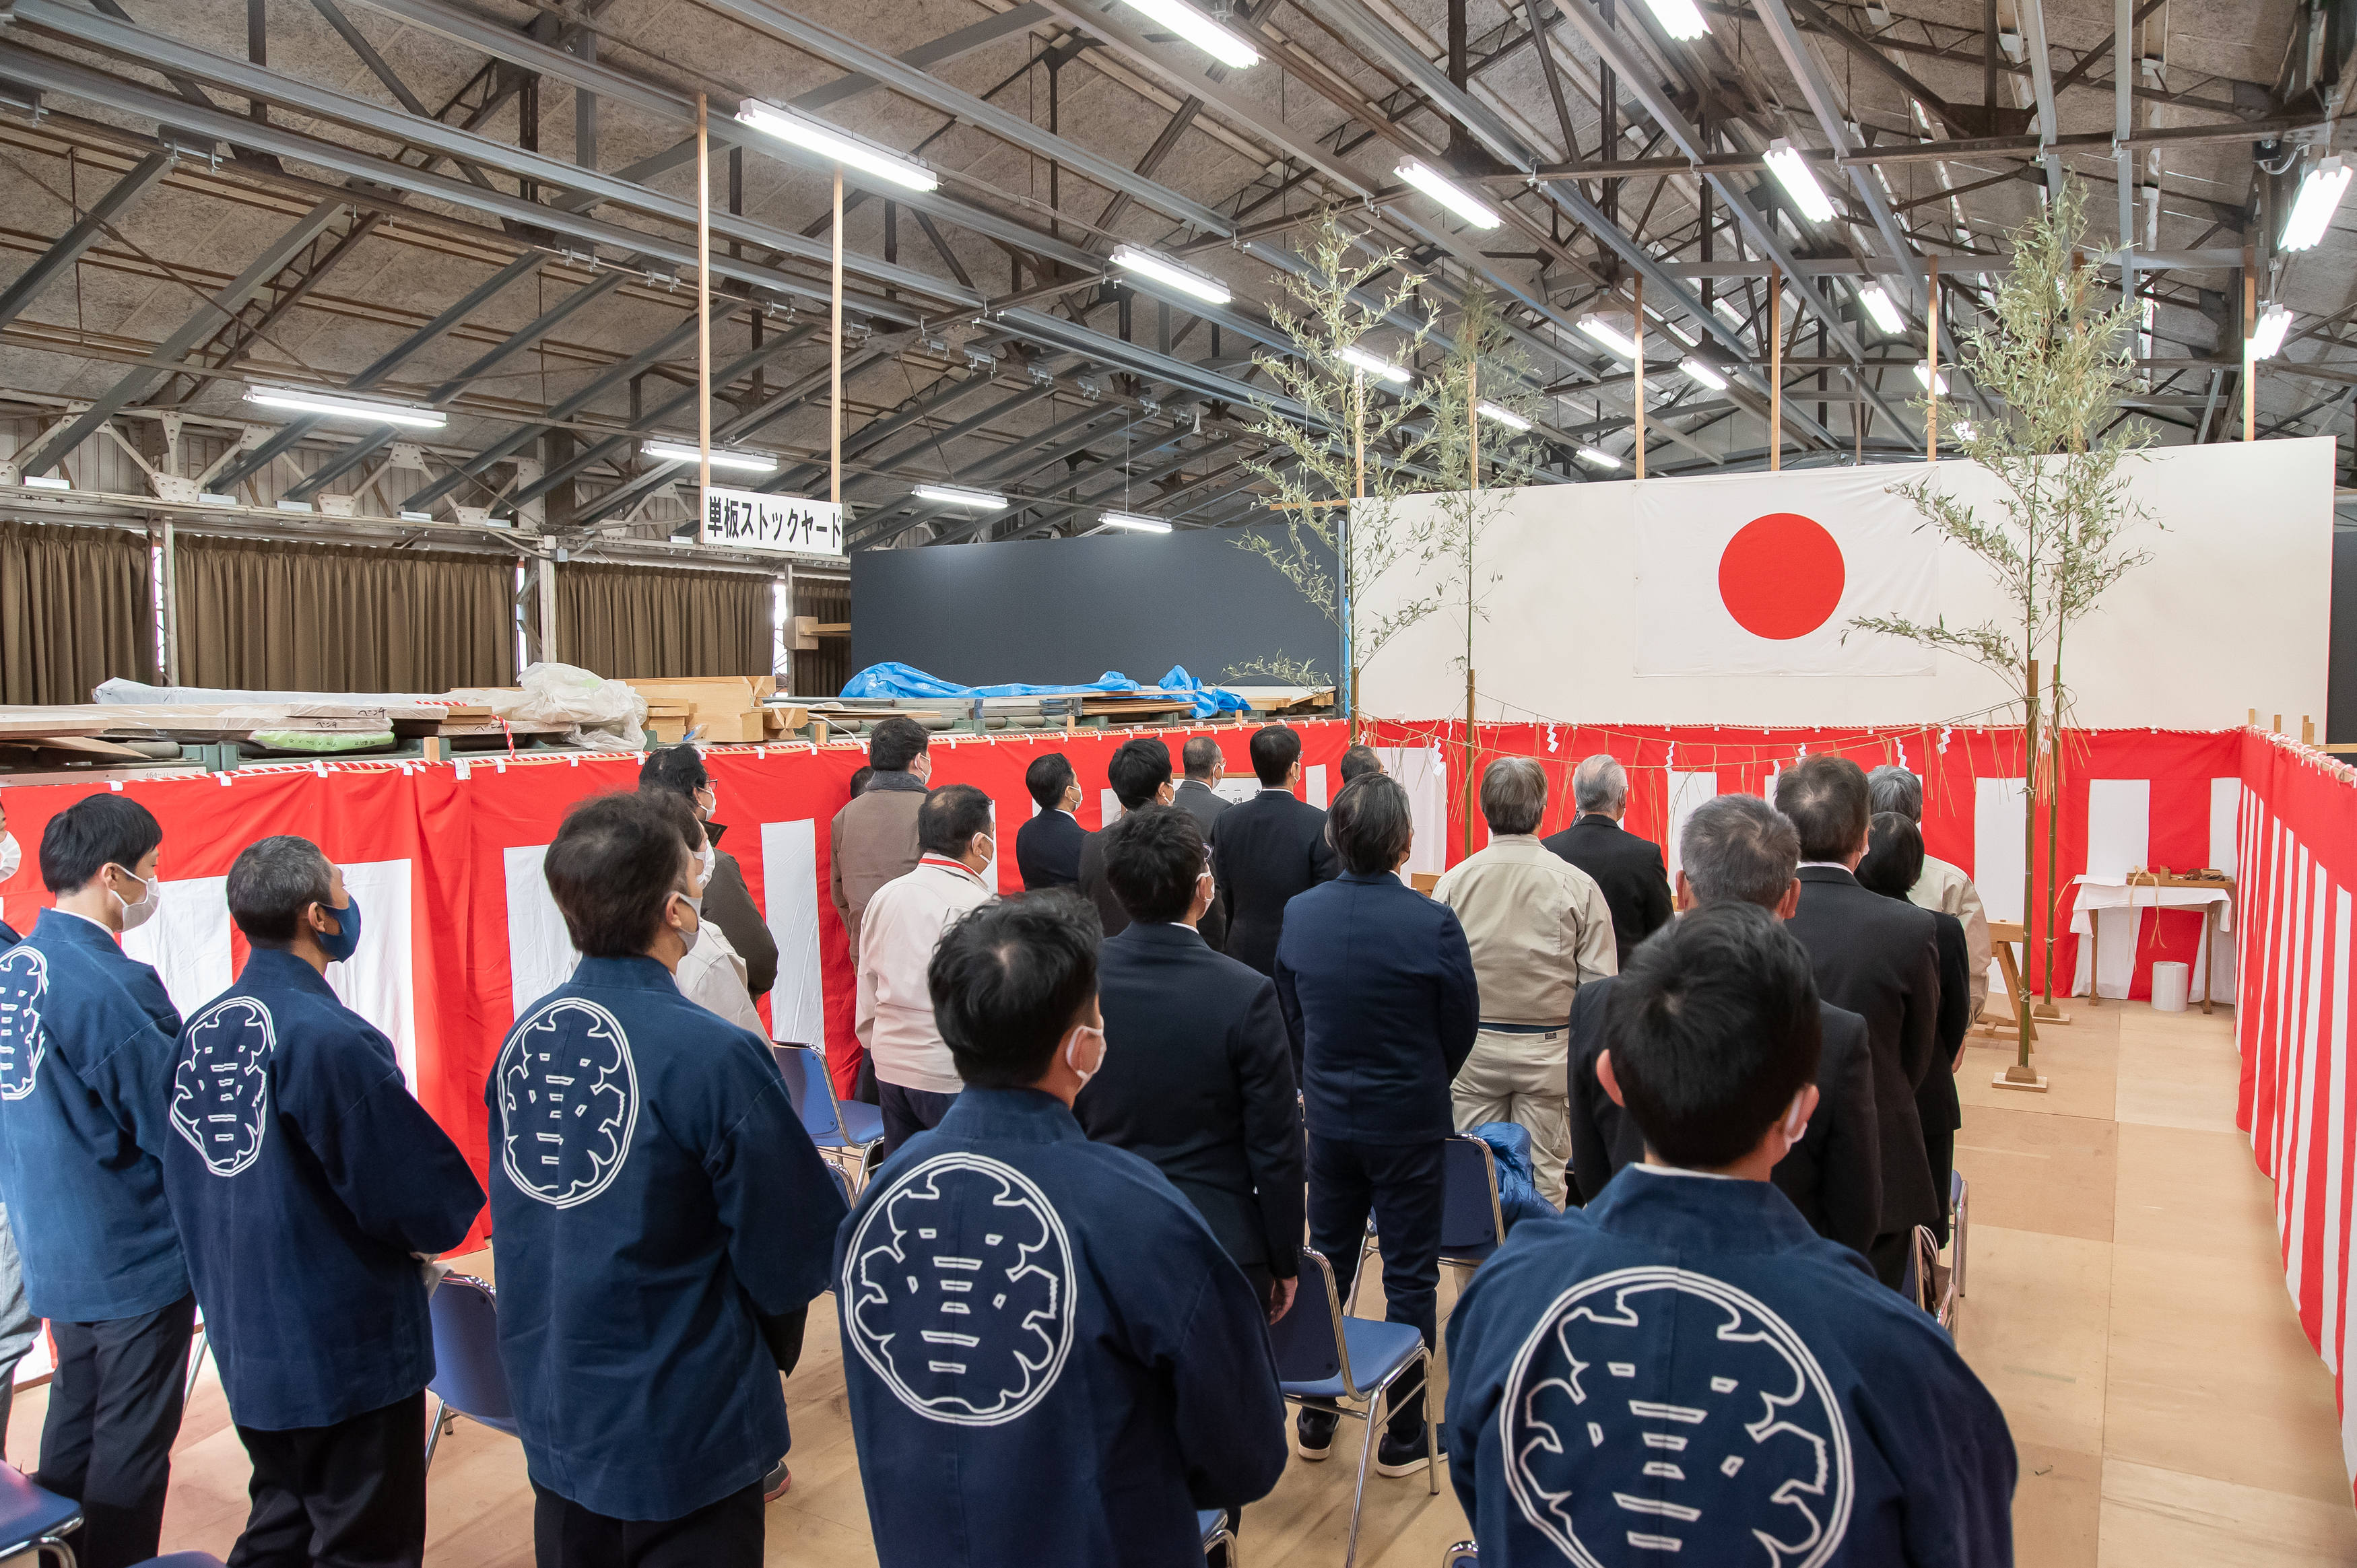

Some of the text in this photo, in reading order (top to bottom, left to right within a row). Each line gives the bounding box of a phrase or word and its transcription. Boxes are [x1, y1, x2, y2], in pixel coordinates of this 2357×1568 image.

[708, 496, 841, 548] 単板ストックヤード
